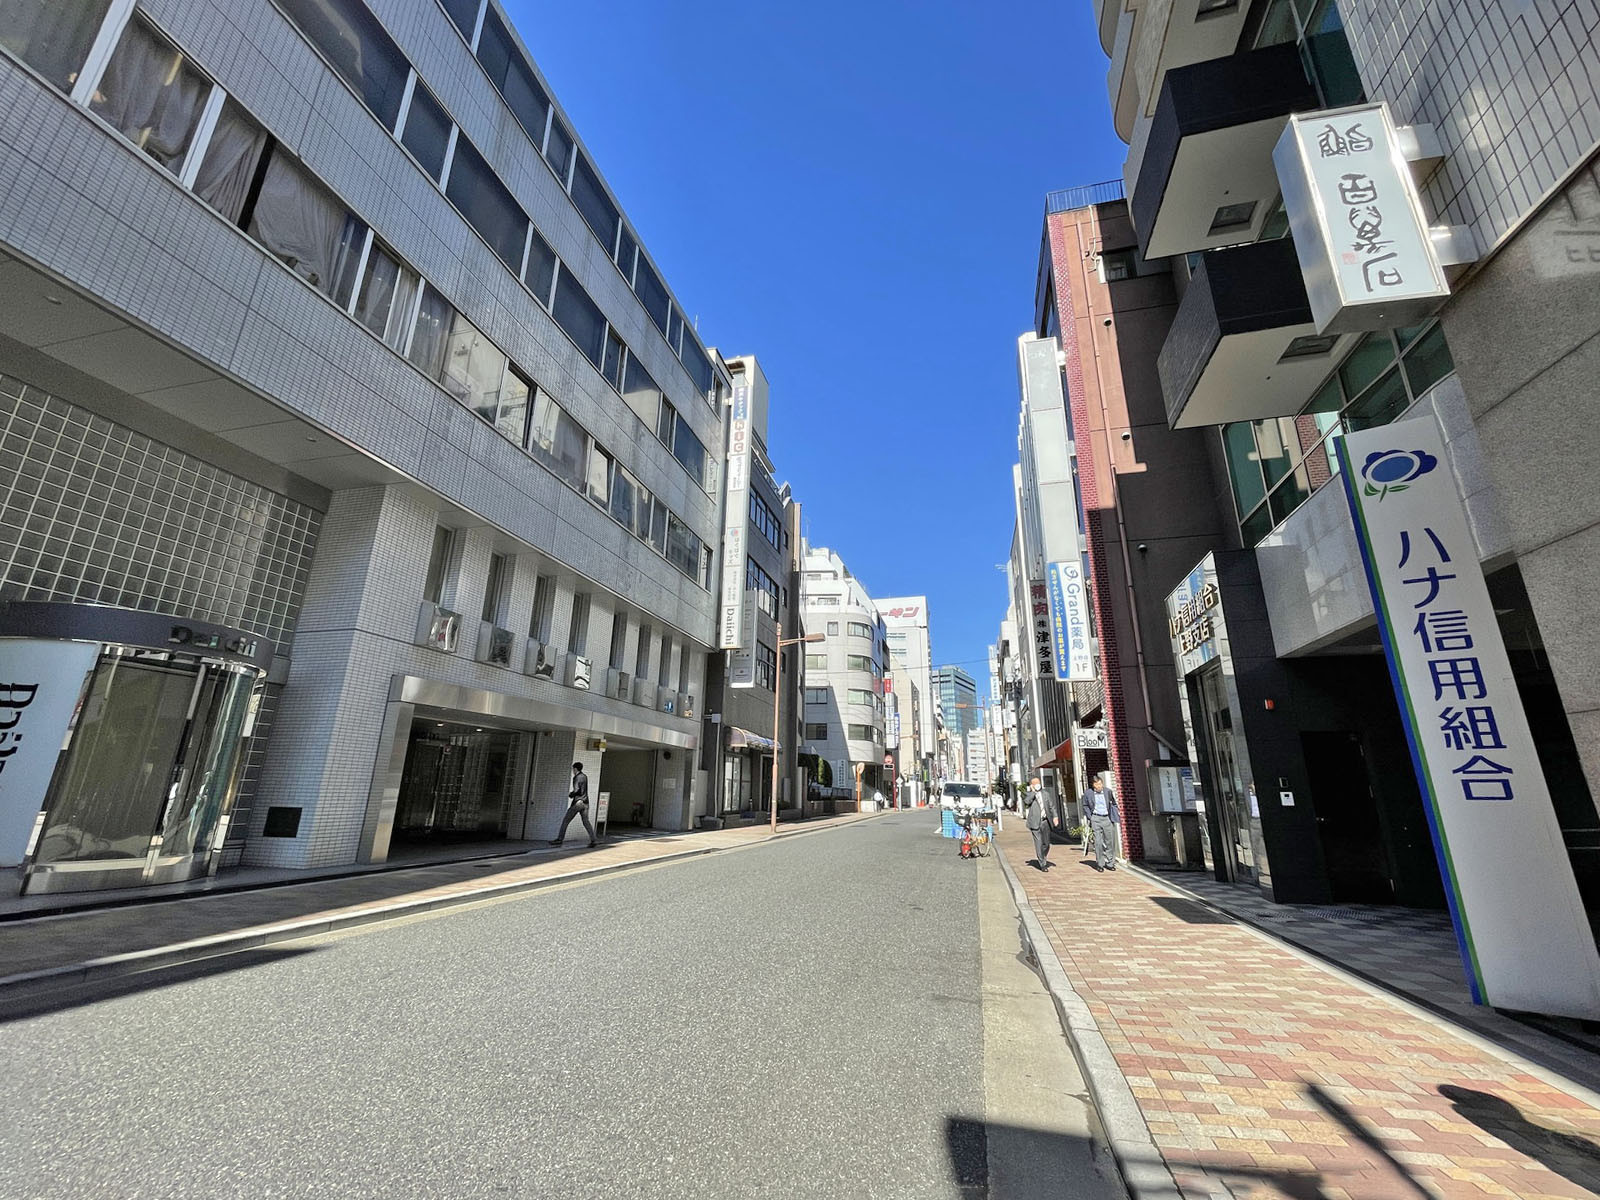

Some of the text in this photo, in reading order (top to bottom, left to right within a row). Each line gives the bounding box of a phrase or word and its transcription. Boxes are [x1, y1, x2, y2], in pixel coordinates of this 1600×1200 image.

[724, 608, 734, 645] Daiichi
[1067, 583, 1084, 649] Grand薬局
[1168, 583, 1219, 639] ハナ信用組合
[1075, 663, 1088, 672] 1F
[1399, 527, 1514, 801] ハナ信用組合
